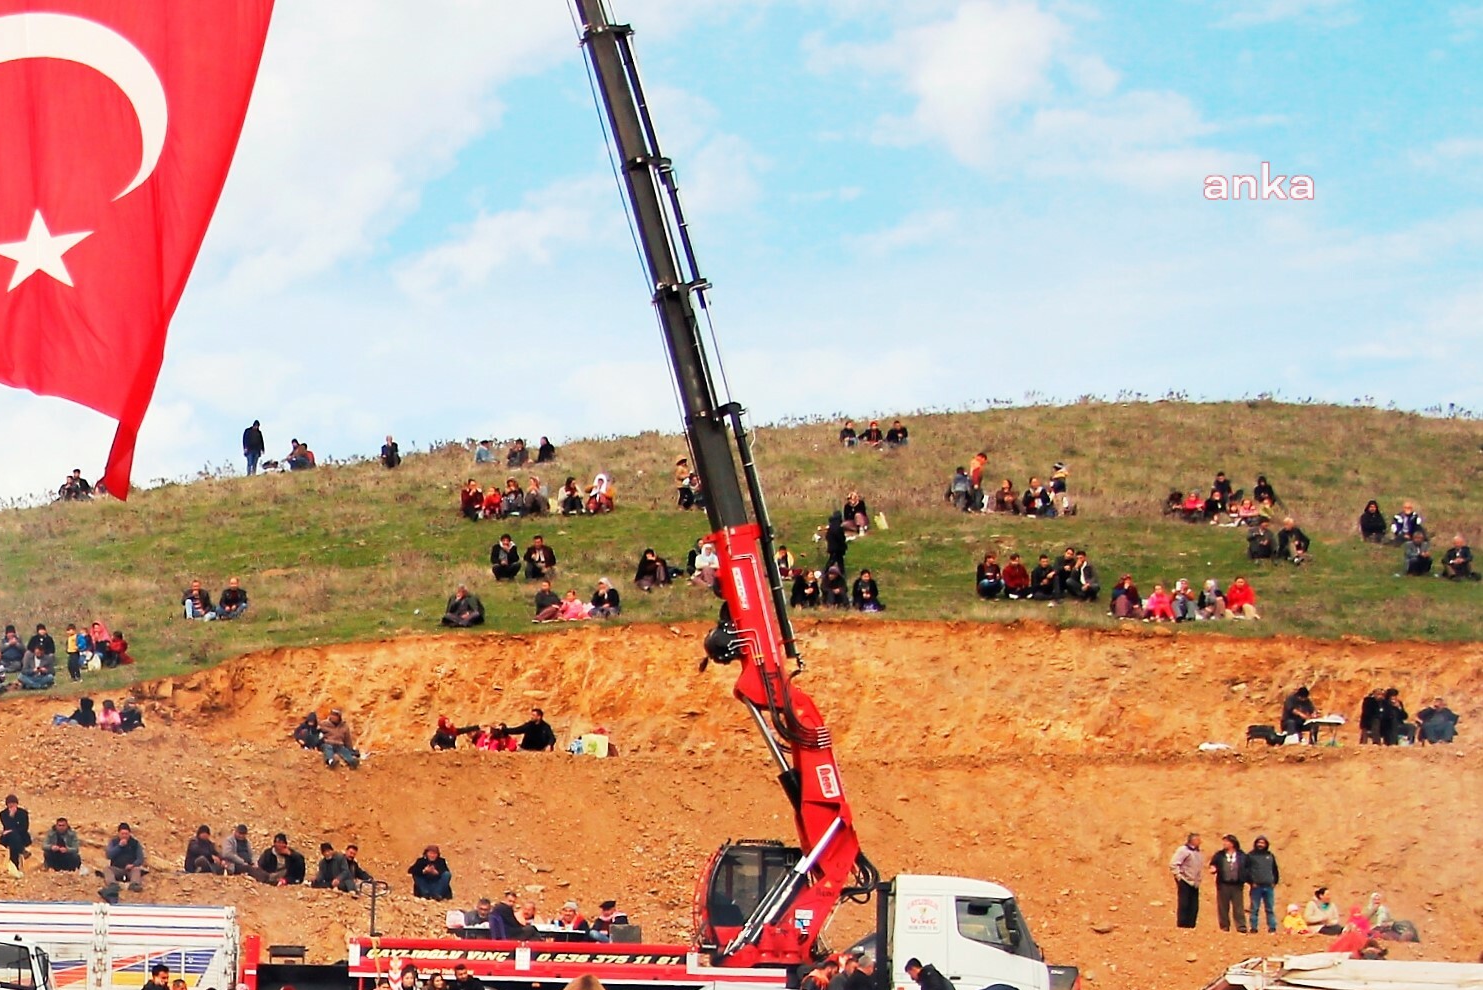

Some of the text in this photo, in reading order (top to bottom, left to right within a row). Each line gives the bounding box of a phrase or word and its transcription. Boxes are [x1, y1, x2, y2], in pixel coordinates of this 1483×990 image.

[536, 952, 589, 963] 0.536
[591, 954, 628, 965] 375
[632, 955, 651, 965] 11
